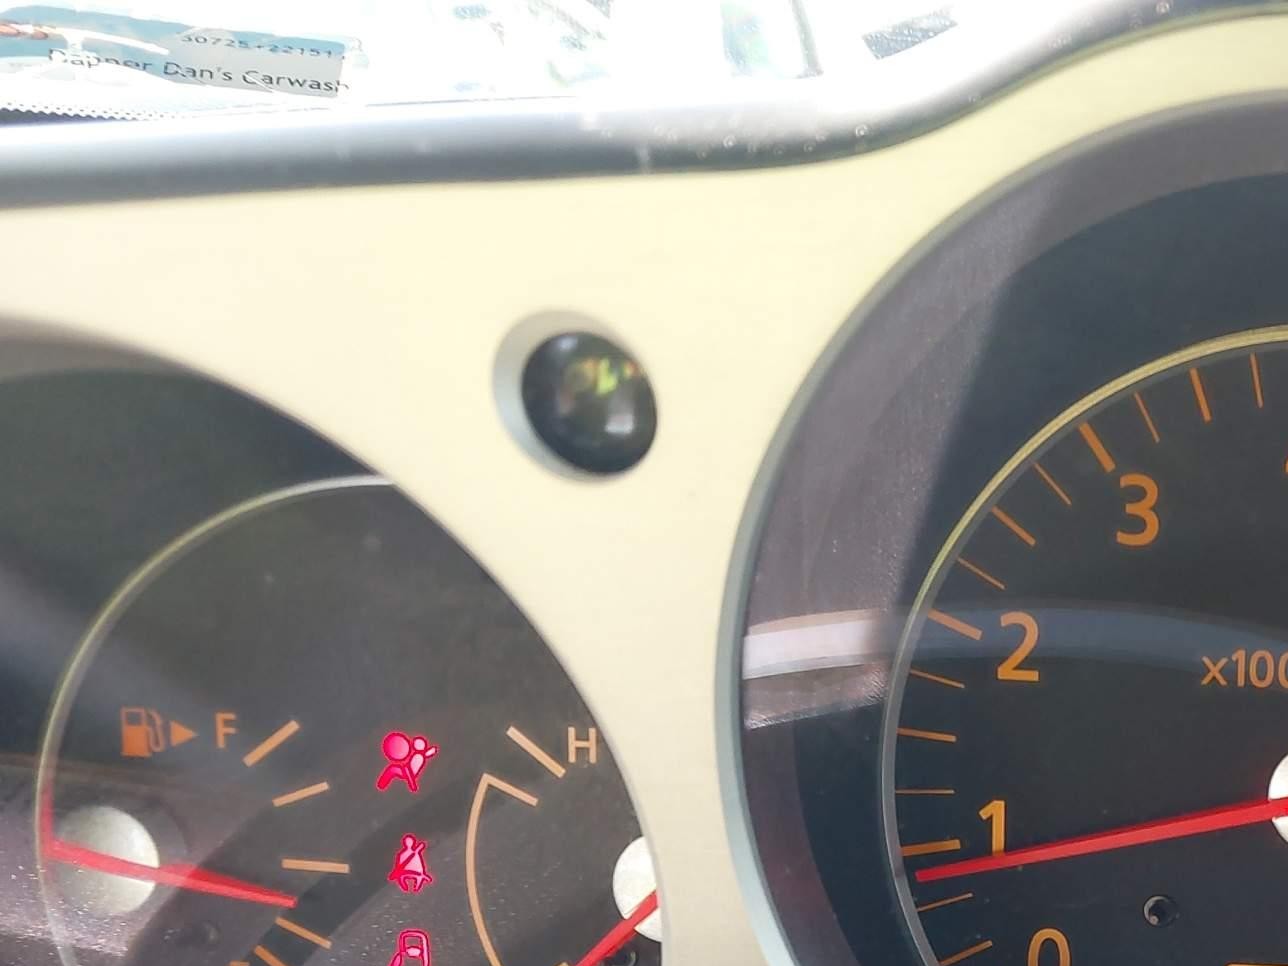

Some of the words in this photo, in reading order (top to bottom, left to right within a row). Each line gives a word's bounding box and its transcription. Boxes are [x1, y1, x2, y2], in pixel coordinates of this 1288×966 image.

[163, 60, 232, 80] Dan's
[1116, 473, 1160, 547] 3
[997, 611, 1039, 682] 2
[216, 712, 236, 747] F
[567, 726, 597, 765] H
[978, 800, 1005, 856] 1
